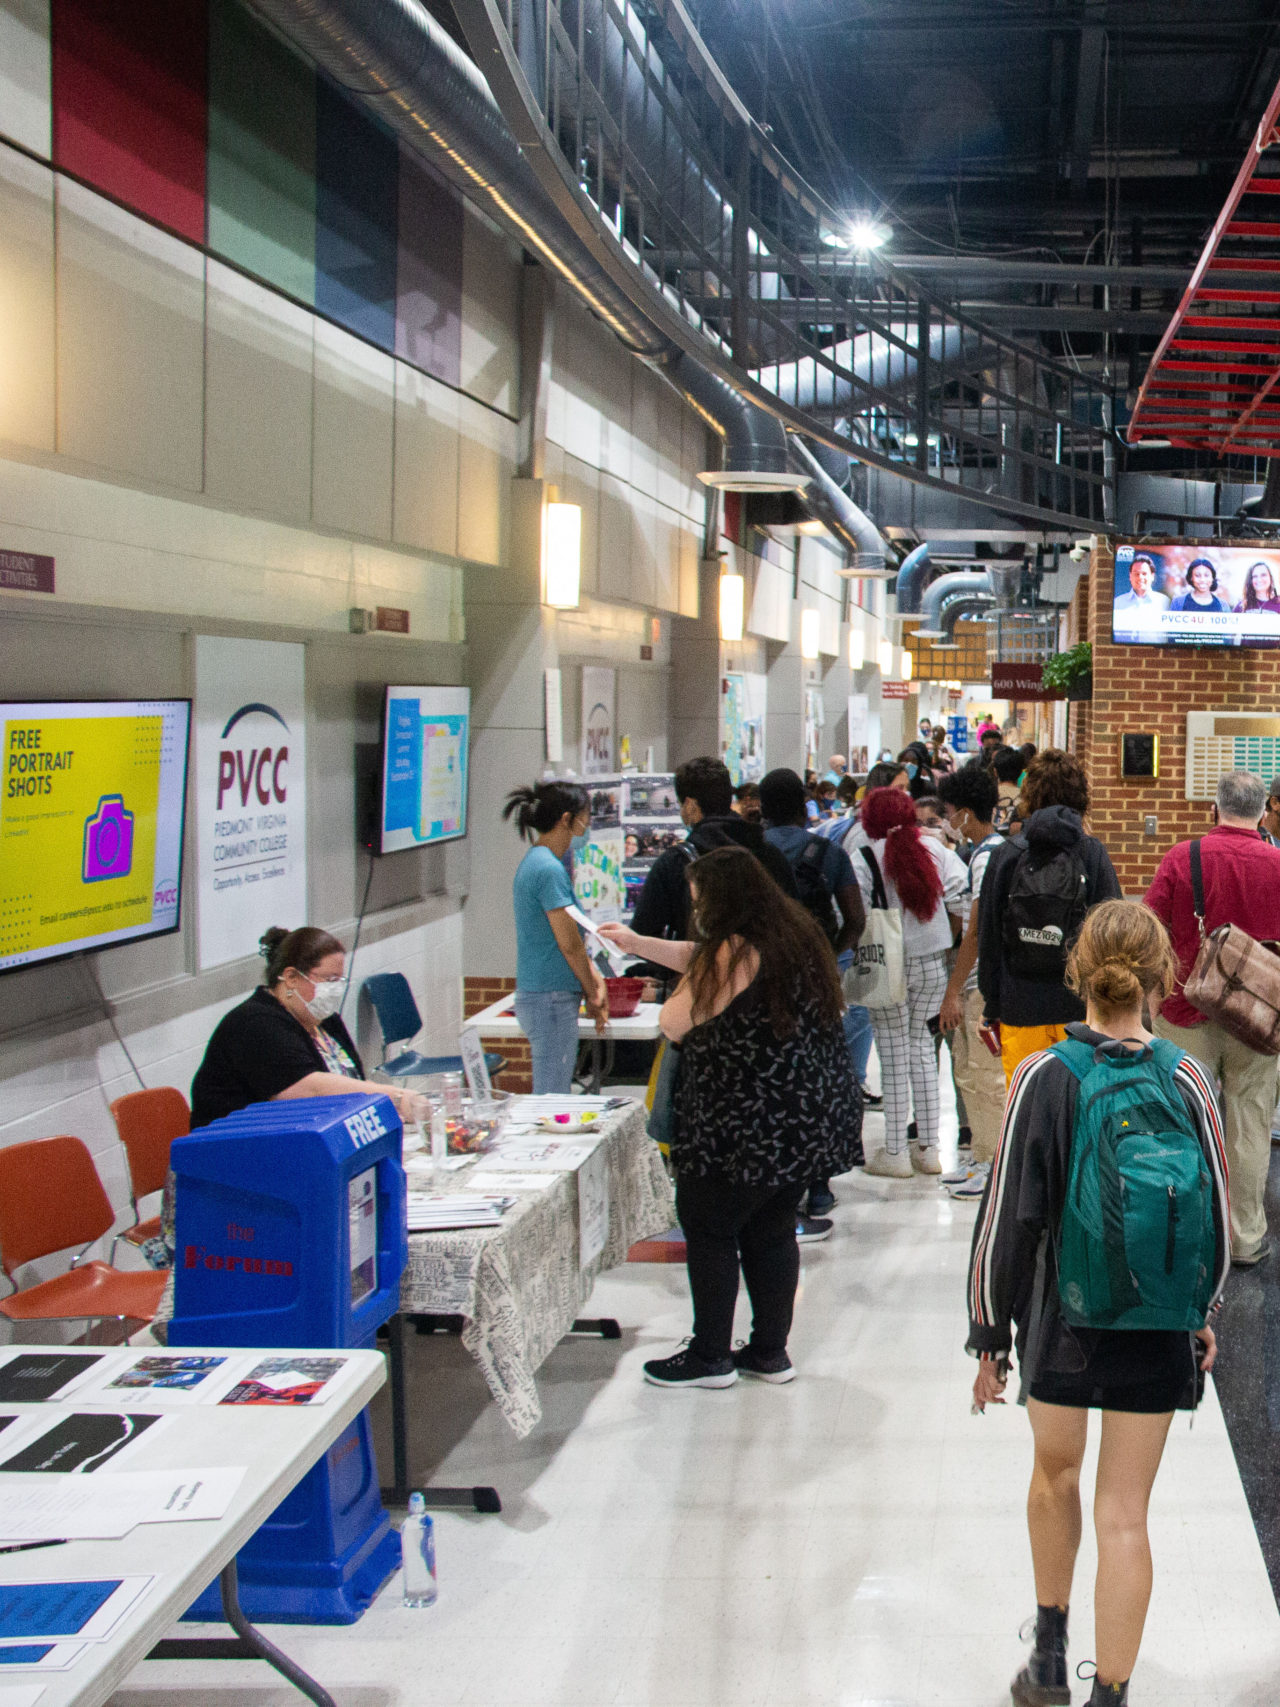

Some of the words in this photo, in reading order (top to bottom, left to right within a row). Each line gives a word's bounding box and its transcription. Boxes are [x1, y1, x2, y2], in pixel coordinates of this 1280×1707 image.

[0, 554, 35, 571] TUDENT
[0, 570, 38, 587] CTIVITIES
[993, 679, 1013, 689] 600
[1016, 679, 1044, 693] Wing
[10, 729, 41, 749] FREE
[9, 751, 74, 774] PORTRAIT
[8, 776, 52, 798] SHOTS
[216, 746, 288, 810] PVCC
[215, 817, 254, 837] PIEDMONT
[257, 813, 287, 831] VIRGINIA
[213, 839, 257, 862] COMMUNITY
[260, 834, 287, 853] COLLEGE
[155, 888, 177, 905] PVCC
[343, 1104, 387, 1150] FREE
[227, 1223, 255, 1242] the
[184, 1245, 293, 1277] Forum
